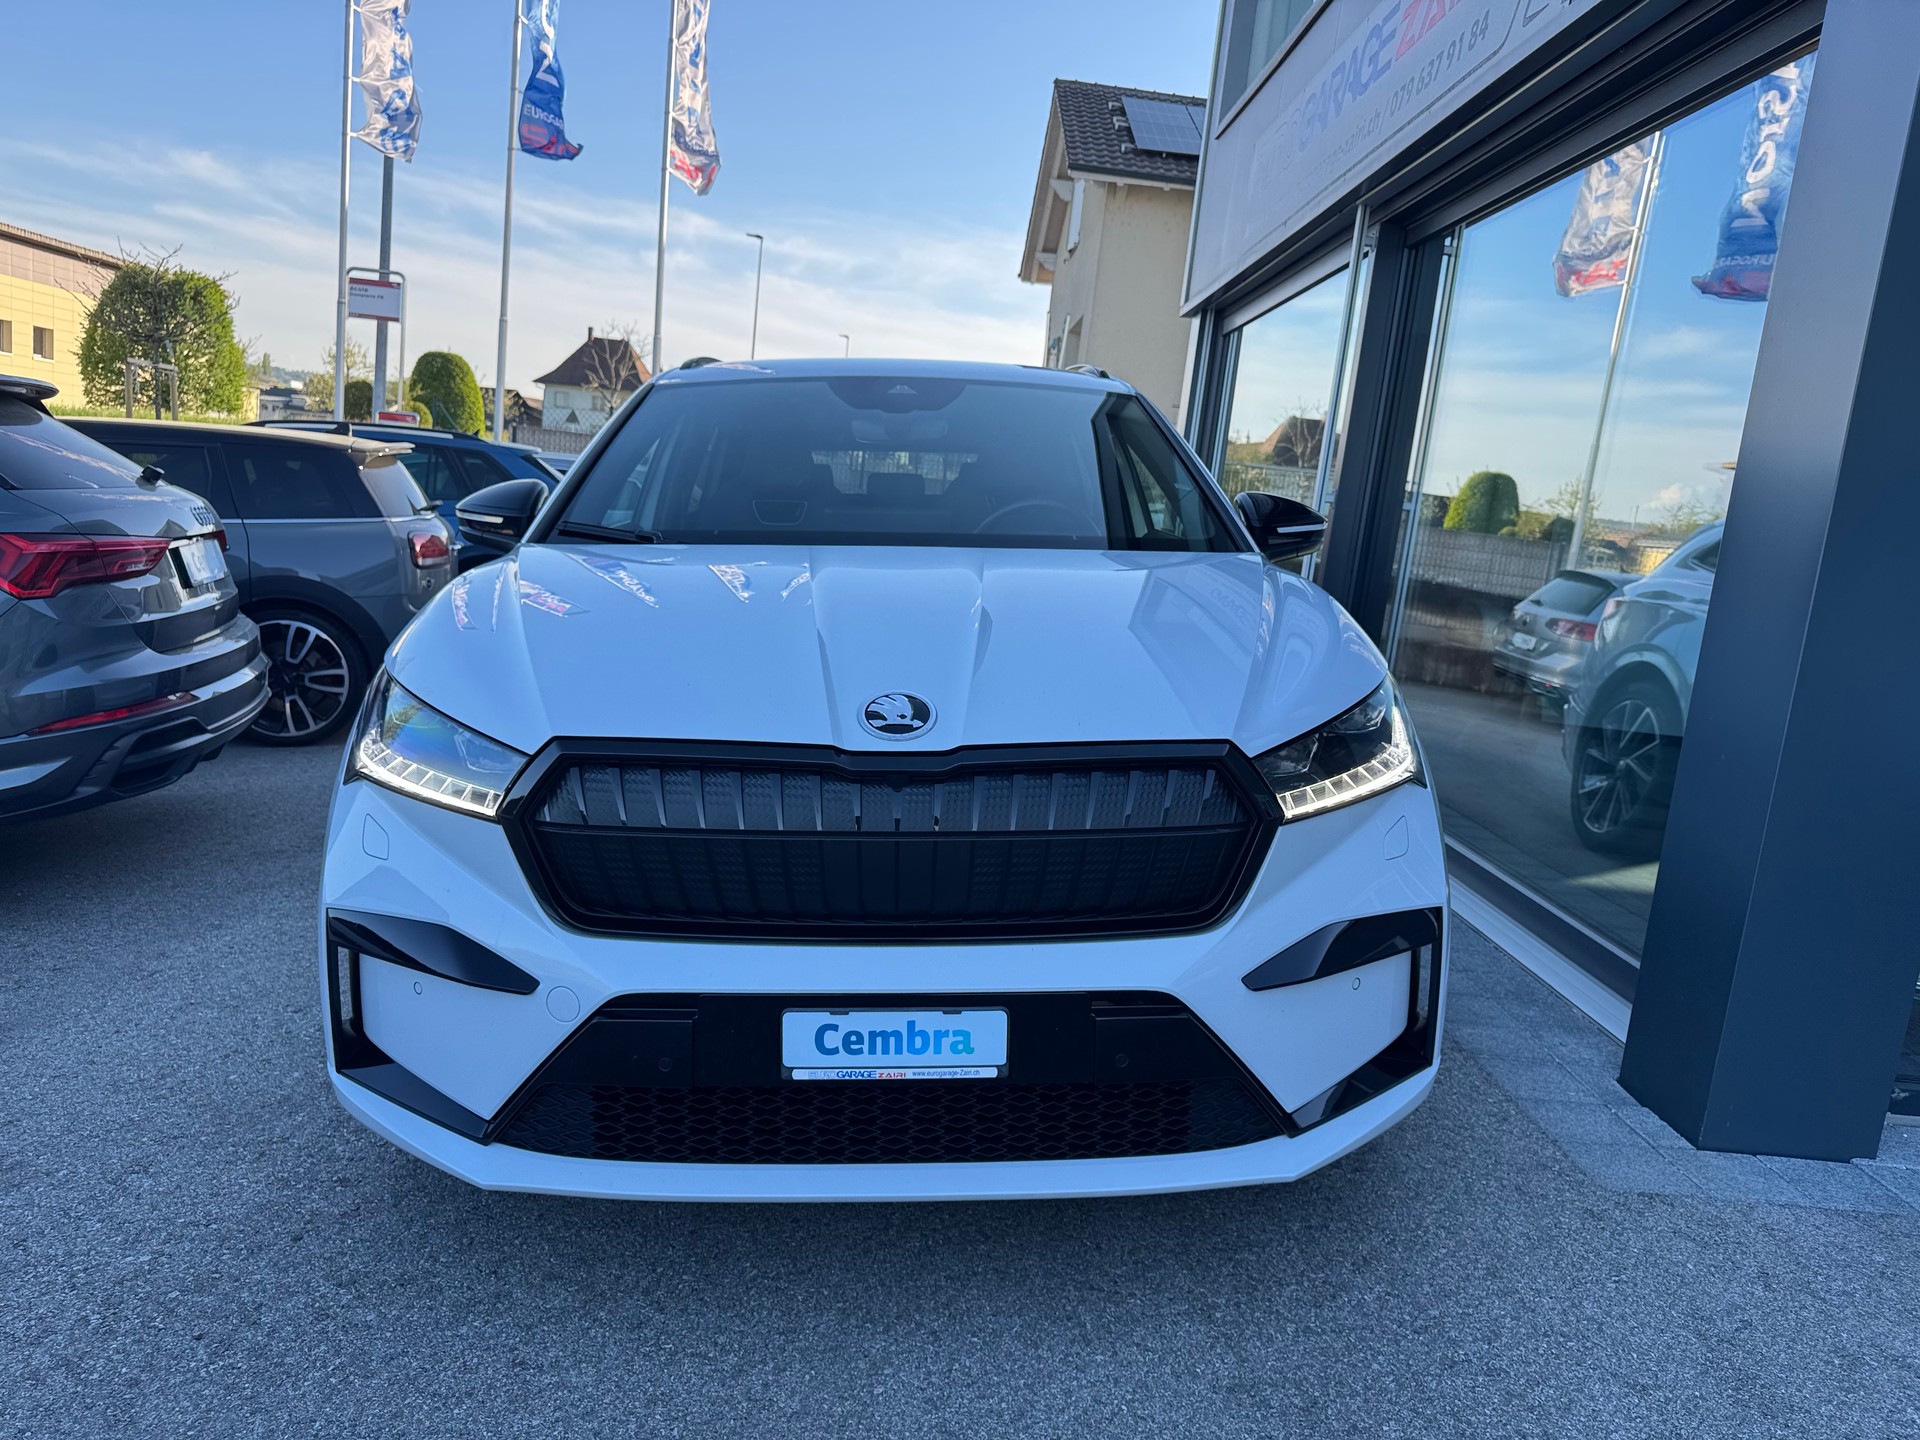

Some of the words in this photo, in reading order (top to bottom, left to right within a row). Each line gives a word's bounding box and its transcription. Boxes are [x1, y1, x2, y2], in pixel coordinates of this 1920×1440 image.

[1390, 76, 1415, 118] 079
[1416, 49, 1445, 95] 637
[1446, 30, 1466, 71] 91
[1468, 8, 1491, 52] 84
[814, 1019, 975, 1056] Cembra
